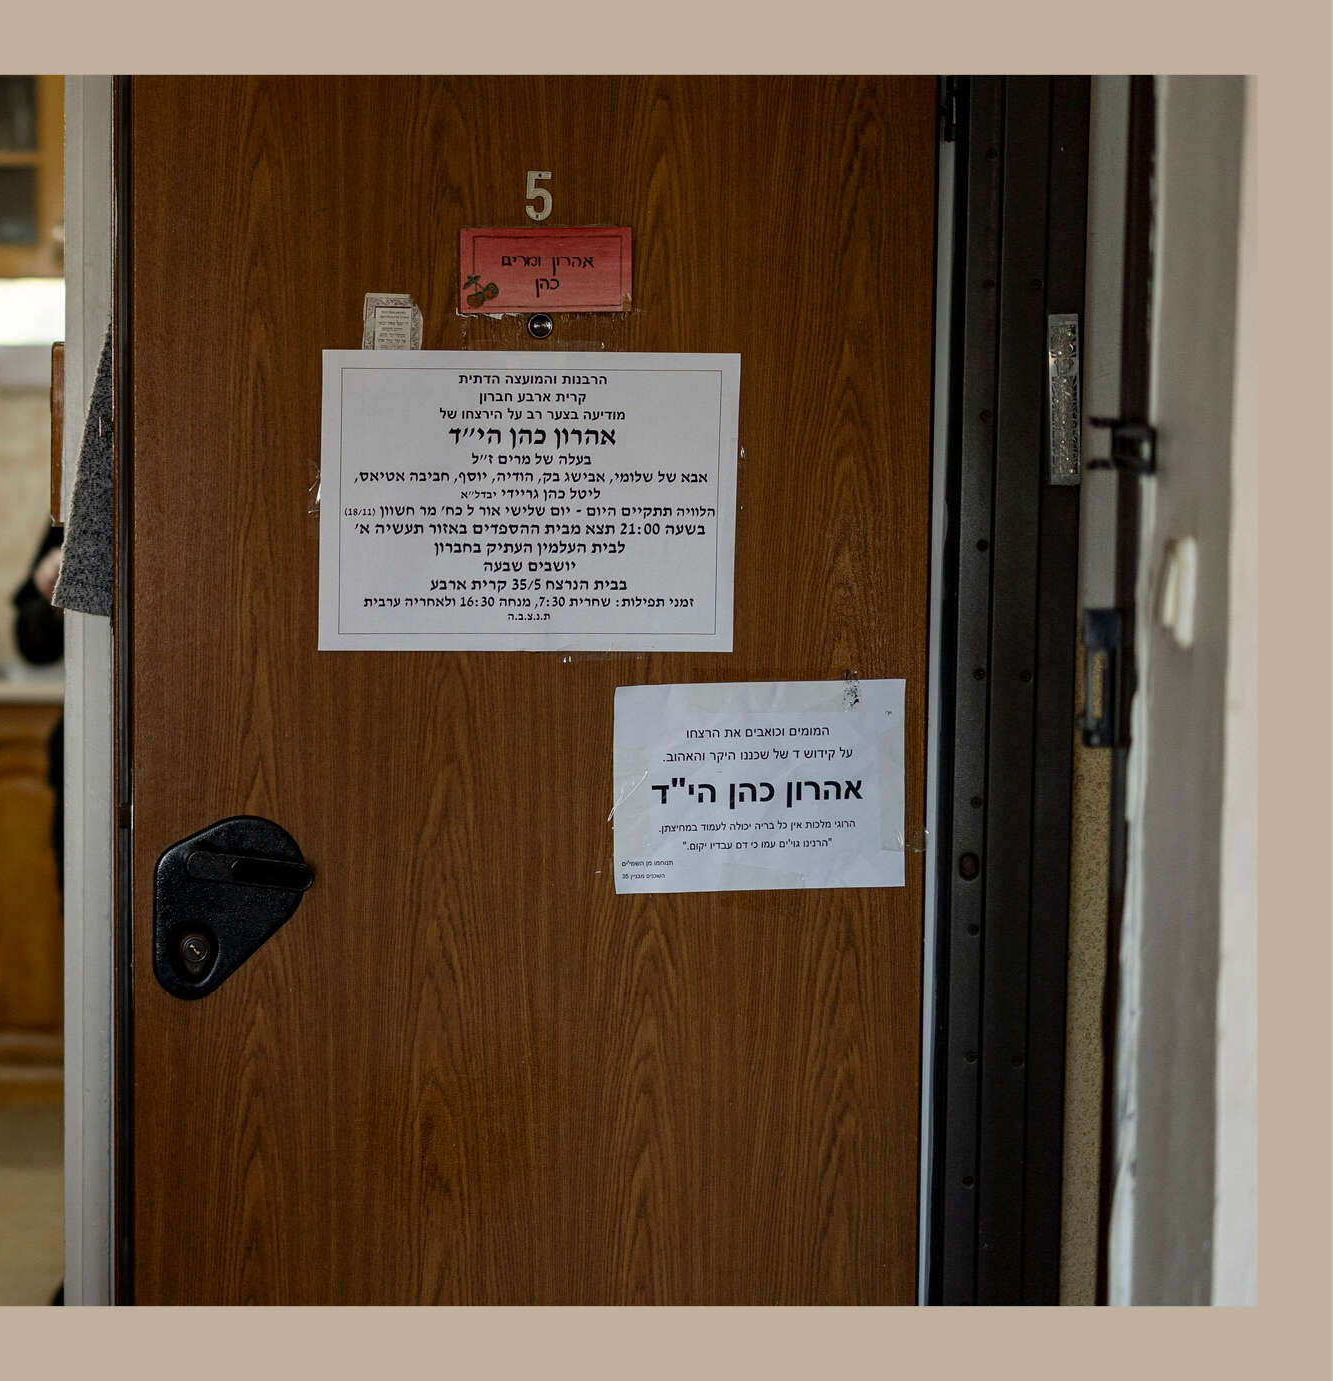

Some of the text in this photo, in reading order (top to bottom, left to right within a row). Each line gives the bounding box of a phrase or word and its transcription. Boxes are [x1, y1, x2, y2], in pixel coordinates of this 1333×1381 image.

[525, 170, 553, 222] 5
[501, 255, 594, 277] אהרון ומרים
[535, 278, 560, 299] כהן
[458, 375, 607, 385] הרבנות והמועצה הדתית
[479, 392, 586, 406] קרית ארבע חברון
[439, 407, 625, 421] מודיעה בצער רב על הירצחו של
[509, 427, 546, 450] כהן
[553, 427, 616, 450] אהרון
[497, 454, 531, 465] מרים
[535, 452, 553, 465] של
[558, 452, 592, 466] בעלה
[354, 470, 708, 485] אבא של שלומי, אבישג בק, הודיה, יוסף, חביבה אטיאס,
[501, 489, 539, 500] גריידי
[543, 489, 566, 502] כהן
[569, 487, 601, 500] ליטל
[344, 507, 376, 517] (18/11)
[379, 505, 415, 519] חשוון
[419, 506, 437, 516] מר
[466, 504, 475, 516] ל
[479, 506, 501, 516] אור
[505, 504, 546, 517] שלישי
[550, 506, 571, 516] יום
[586, 506, 616, 517] היום
[621, 506, 673, 520] תתקיים
[676, 506, 716, 517] הלוויה
[374, 523, 424, 535] תעשיה
[428, 523, 468, 535] באזור
[472, 523, 540, 535] ההספדים
[544, 523, 581, 535] מבית
[585, 523, 615, 535] תצא
[620, 522, 660, 535] 21:00
[665, 524, 706, 536] בשעה
[434, 540, 626, 557] לבית העלמין העתיק בחברון
[483, 561, 576, 573] יושבים שבעה
[430, 578, 628, 594] בבית הנרצח 35/5 קרית ארבע
[363, 595, 694, 610] זמני תפילות: שחרית 7:30, מנחה 16:30 ולאחריה ערבית
[507, 613, 550, 621] ת.נ.צ.ב.ה
[686, 727, 830, 739] המומים וכואבים את הרצחו
[662, 746, 853, 764] על קידוש ד של שכננו היקר והאהוב.
[651, 777, 863, 810] אהרון כהן הי"ד
[658, 819, 856, 835] הרוגי מלכות אין כל בריה יכולה לעמוד במחיצתן.
[710, 842, 733, 850] עבדיו
[735, 841, 748, 850] דם
[750, 841, 759, 849] כי
[761, 841, 776, 849] עמו
